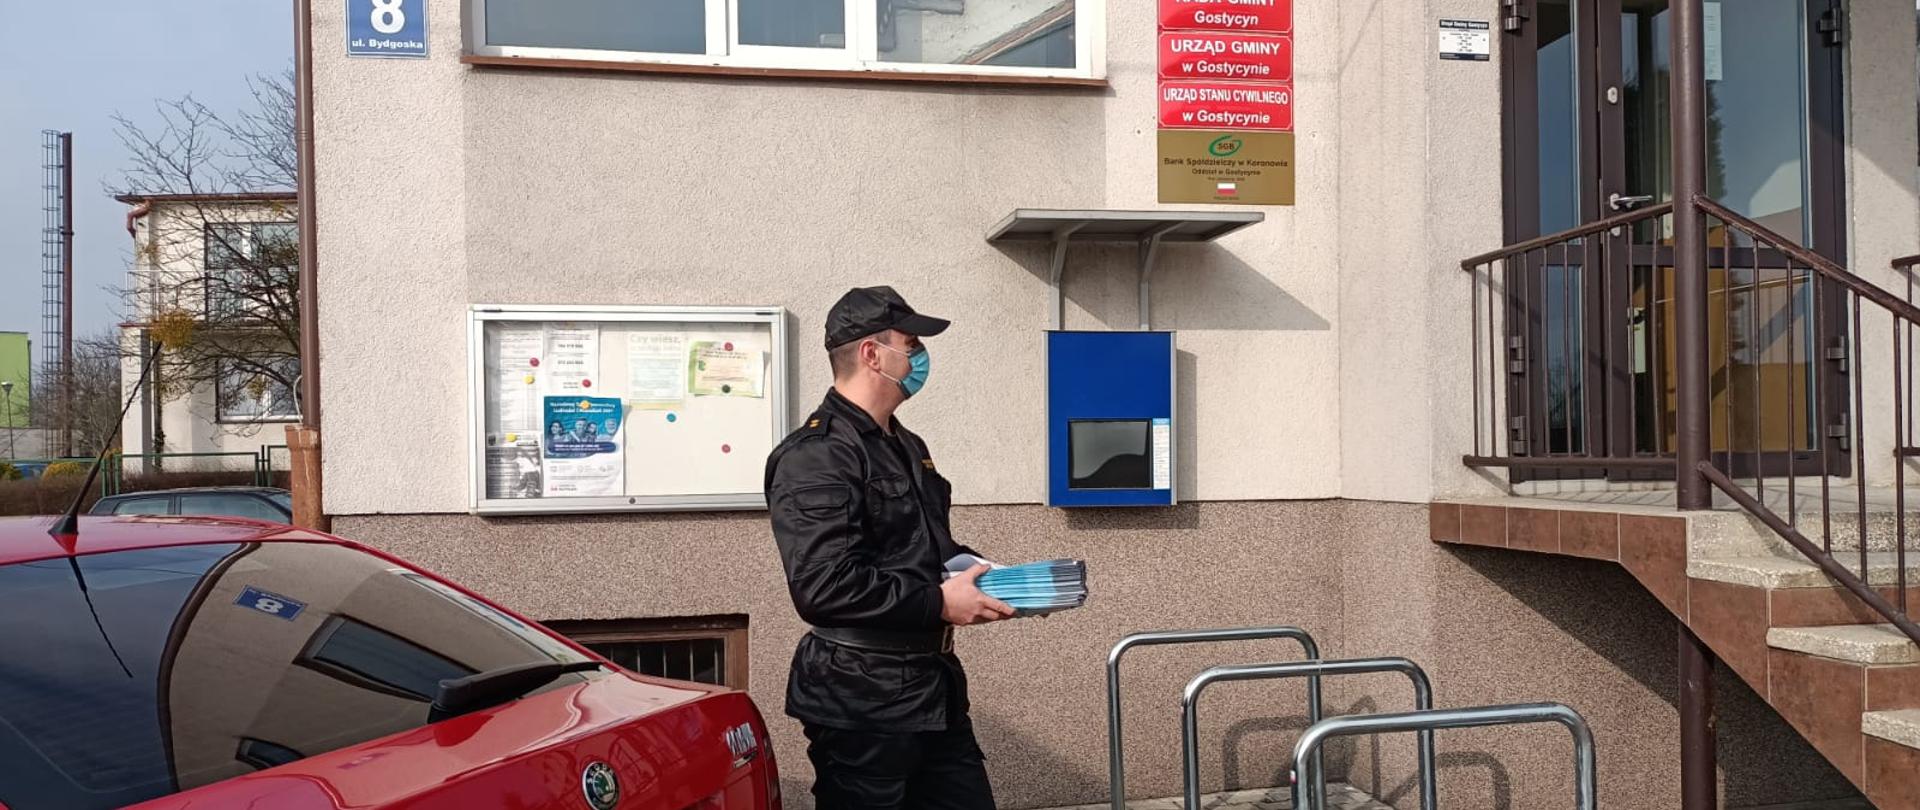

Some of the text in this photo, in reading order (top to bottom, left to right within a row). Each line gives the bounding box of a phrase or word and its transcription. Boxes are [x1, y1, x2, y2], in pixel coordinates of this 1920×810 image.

[371, 0, 405, 34] 8
[1194, 10, 1259, 27] Gostycyn
[352, 39, 423, 49] ul. Bydgoska
[1171, 39, 1280, 55] URZĄD GMINY
[1182, 61, 1270, 77] w Gostycynie
[1164, 88, 1288, 104] URZĄD STANU CYWILNEGO
[1182, 110, 1270, 126] w Gostycynie
